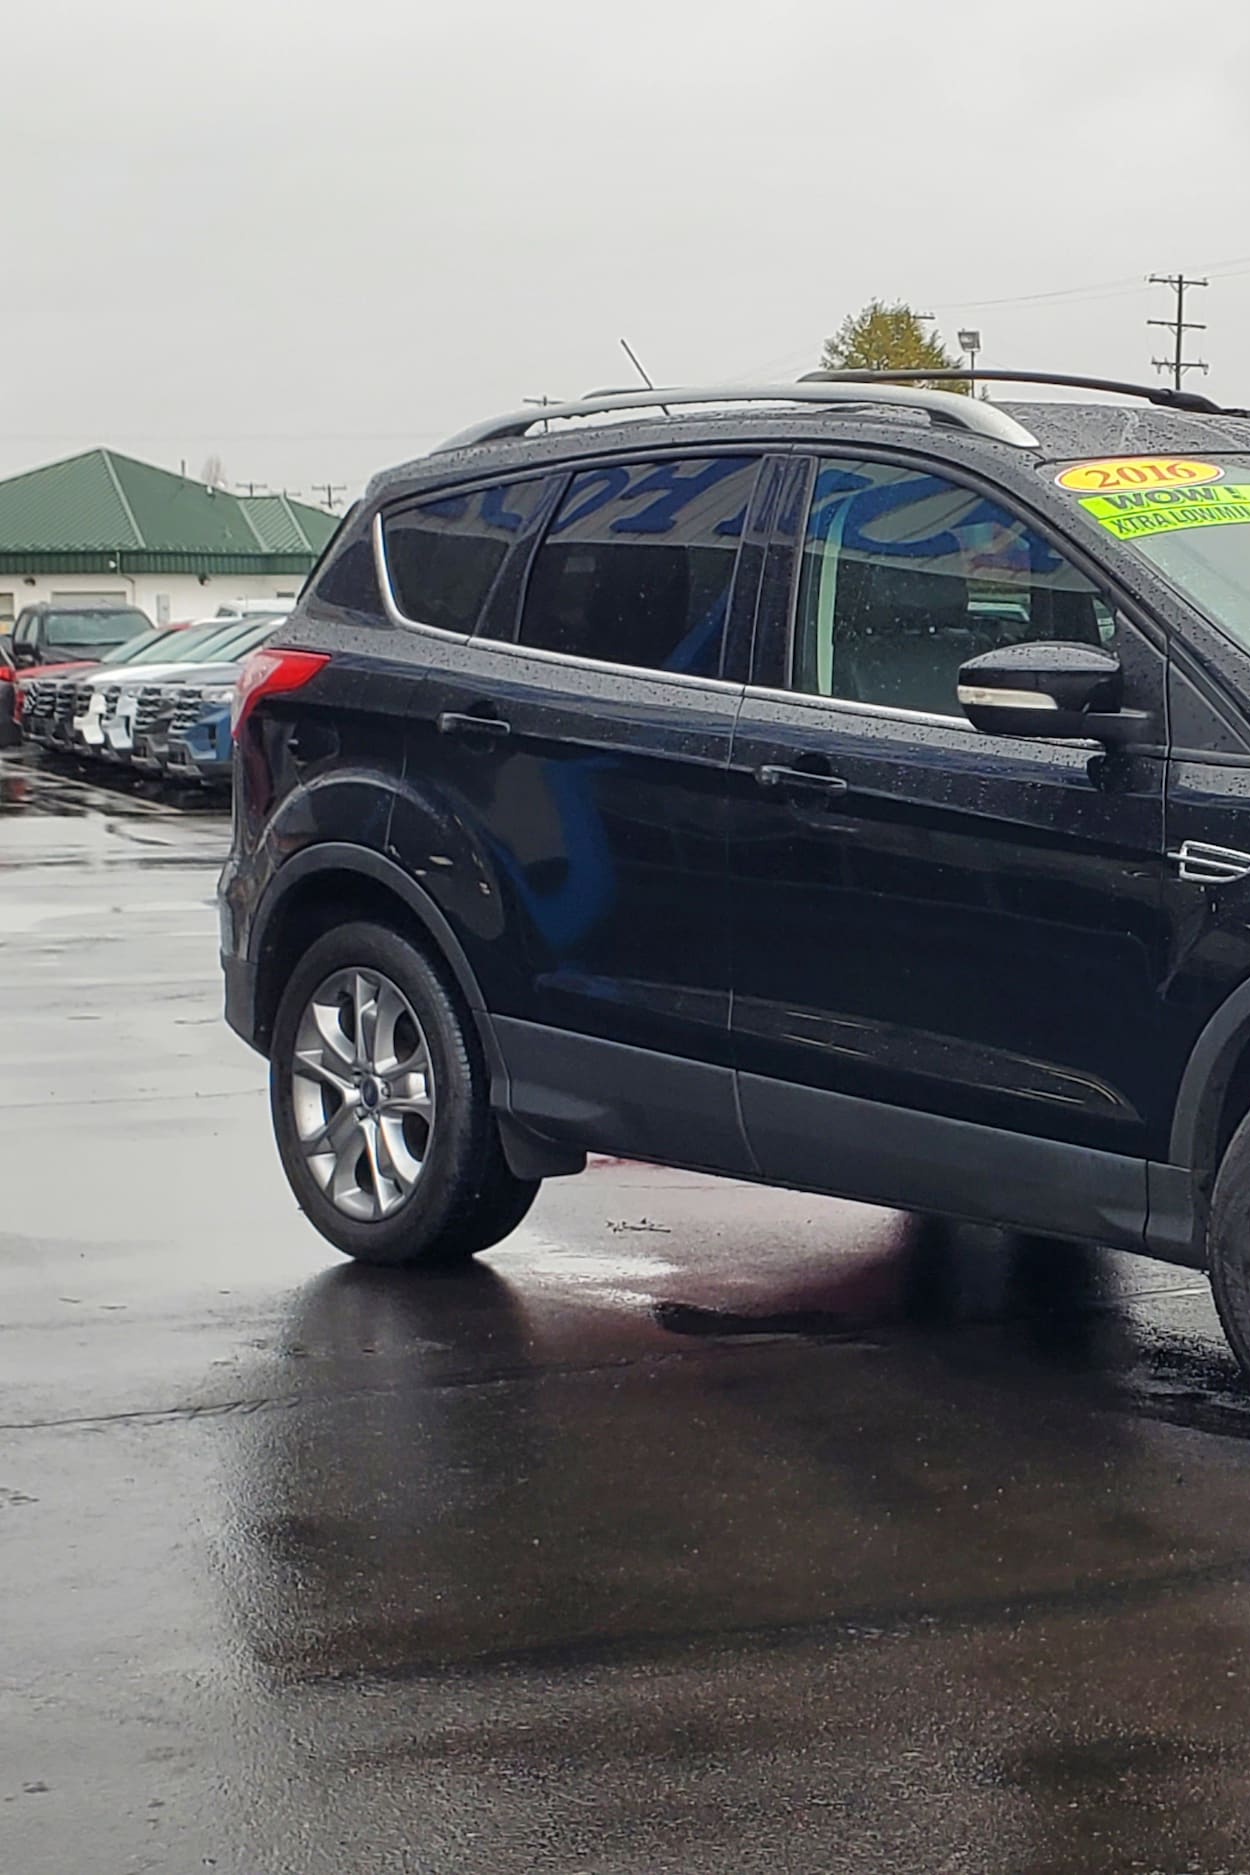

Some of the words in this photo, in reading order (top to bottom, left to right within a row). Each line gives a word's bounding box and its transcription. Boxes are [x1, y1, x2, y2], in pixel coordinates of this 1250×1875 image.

[1084, 463, 1197, 488] 2016
[1102, 487, 1216, 509] WOW
[1109, 512, 1175, 534] XTRA
